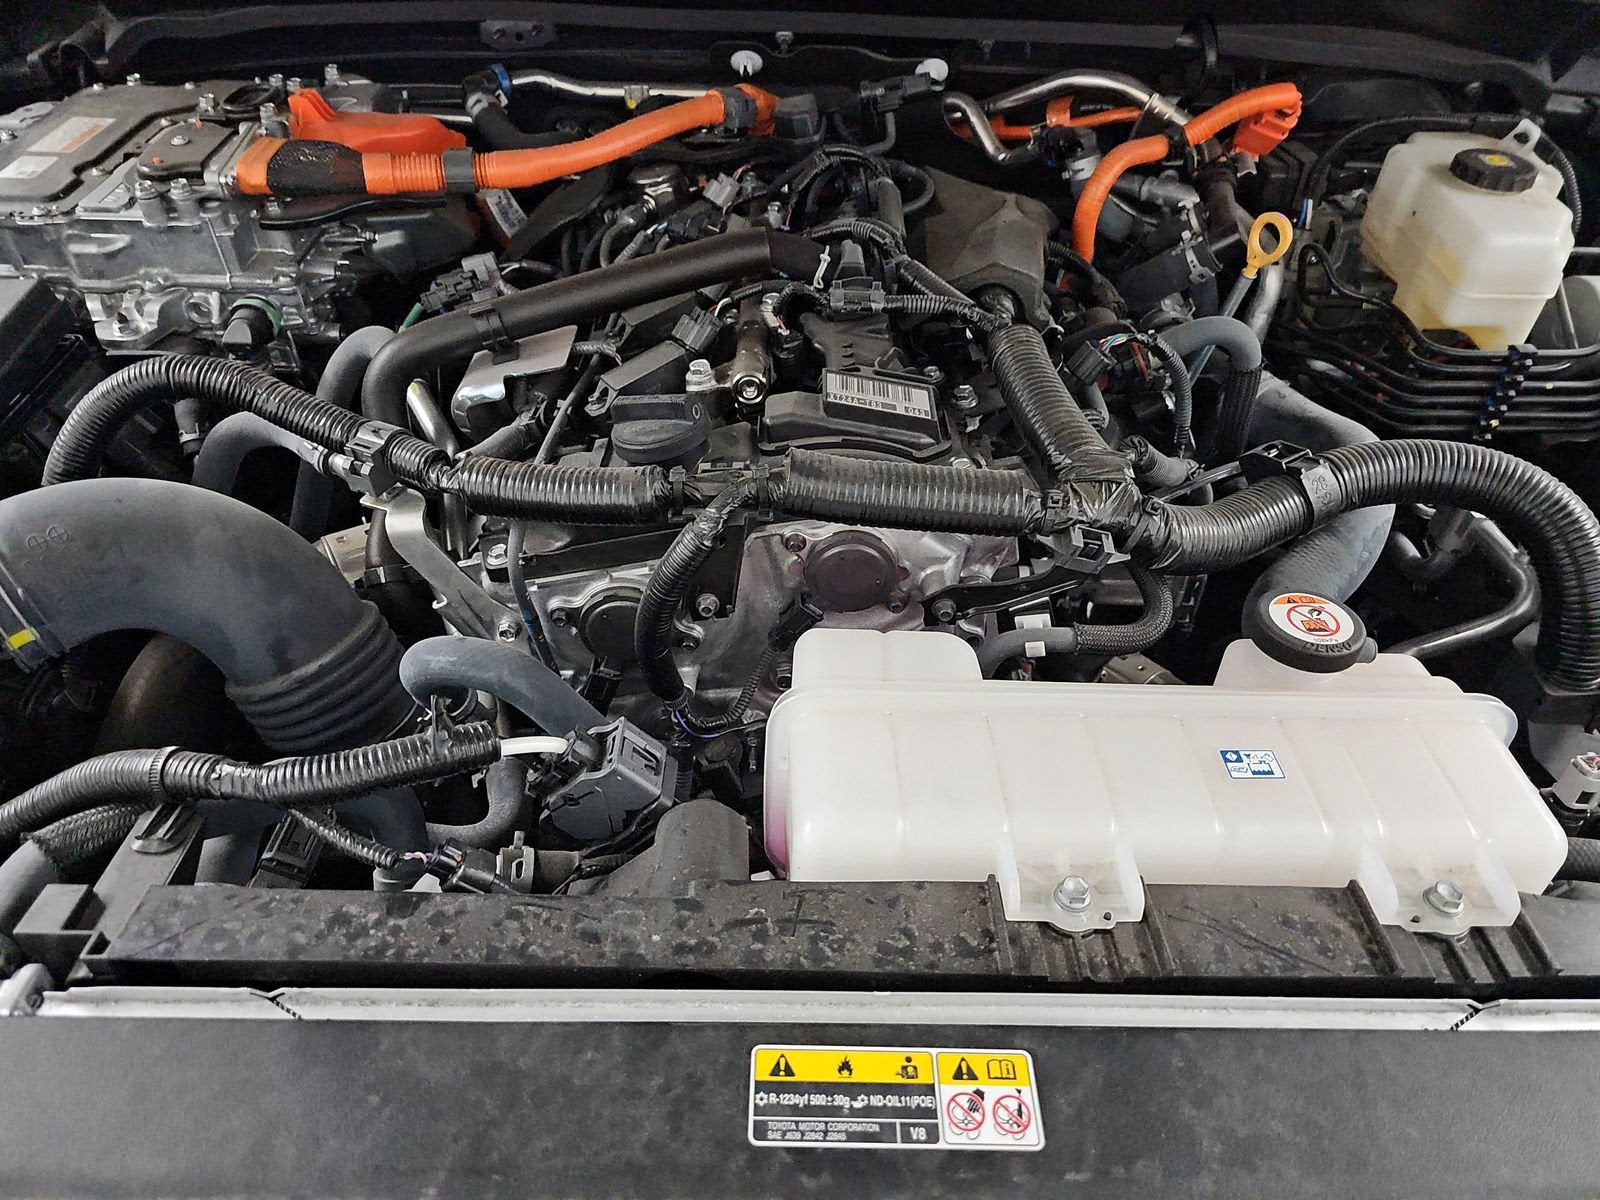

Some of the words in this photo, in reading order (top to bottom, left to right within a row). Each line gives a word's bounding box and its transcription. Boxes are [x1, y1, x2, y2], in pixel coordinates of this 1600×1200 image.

[1303, 641, 1353, 654] DENSO
[769, 1093, 809, 1107] R-1234yf
[767, 1121, 798, 1131] TOYOTA
[799, 1122, 826, 1132] MOTOR
[827, 1123, 880, 1133] CORPORATION
[909, 1126, 927, 1141] V8
[767, 1131, 783, 1140] SAE
